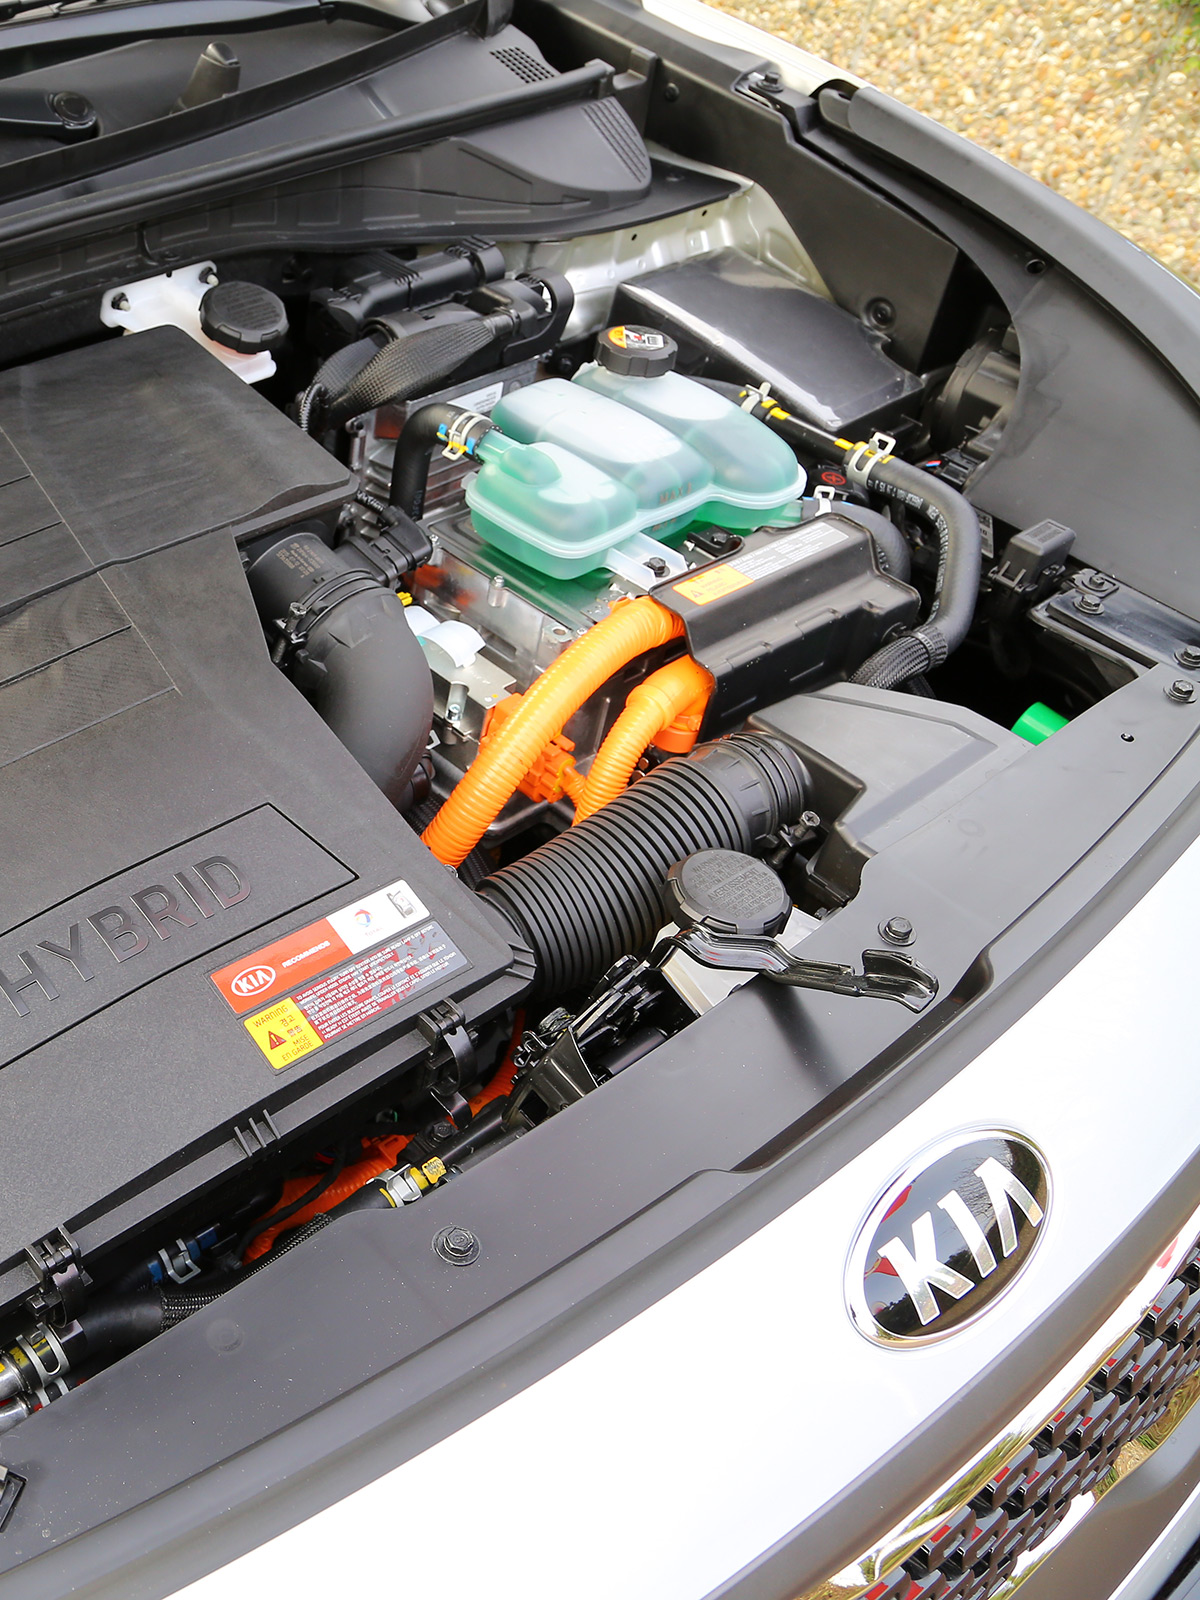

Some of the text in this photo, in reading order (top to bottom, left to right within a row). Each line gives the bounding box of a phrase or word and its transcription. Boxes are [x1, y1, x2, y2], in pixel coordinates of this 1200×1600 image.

[281, 940, 331, 968] RECOMMENDS
[235, 969, 271, 993] KIA
[252, 1004, 289, 1028] WARNING
[281, 1040, 314, 1062] EN GARDE
[293, 1034, 310, 1047] MISE
[875, 1156, 1044, 1326] KIA
